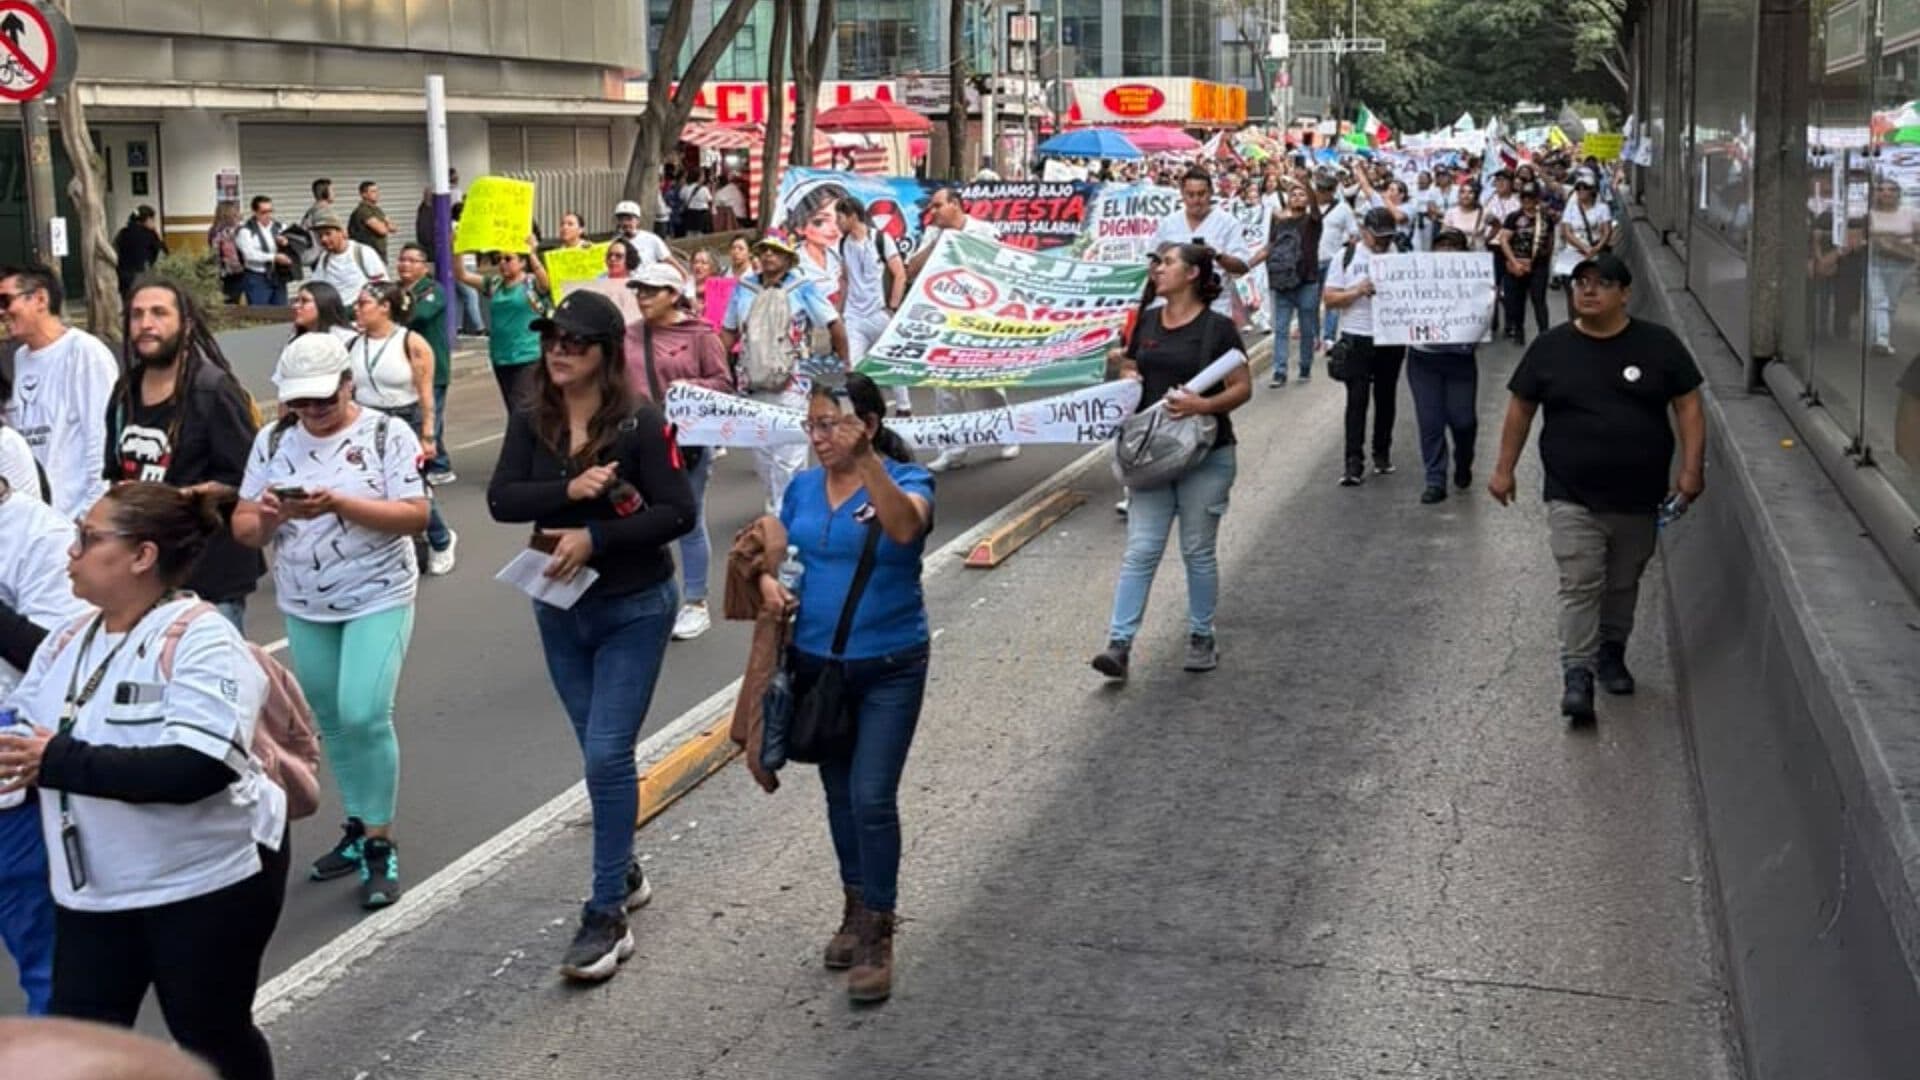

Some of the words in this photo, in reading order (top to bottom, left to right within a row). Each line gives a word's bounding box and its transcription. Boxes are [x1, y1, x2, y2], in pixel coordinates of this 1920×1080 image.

[957, 184, 1036, 199] ABAJAMOS
[1039, 184, 1073, 198] BAJO
[961, 194, 1086, 221] OTESTA
[1103, 199, 1120, 216] EL
[1125, 195, 1171, 216] IMSS
[1098, 218, 1159, 237] DIGNIDA
[994, 247, 1114, 281] RJP
[1007, 287, 1057, 304] No
[960, 316, 1051, 334] Salario
[1408, 325, 1451, 341] IMSS
